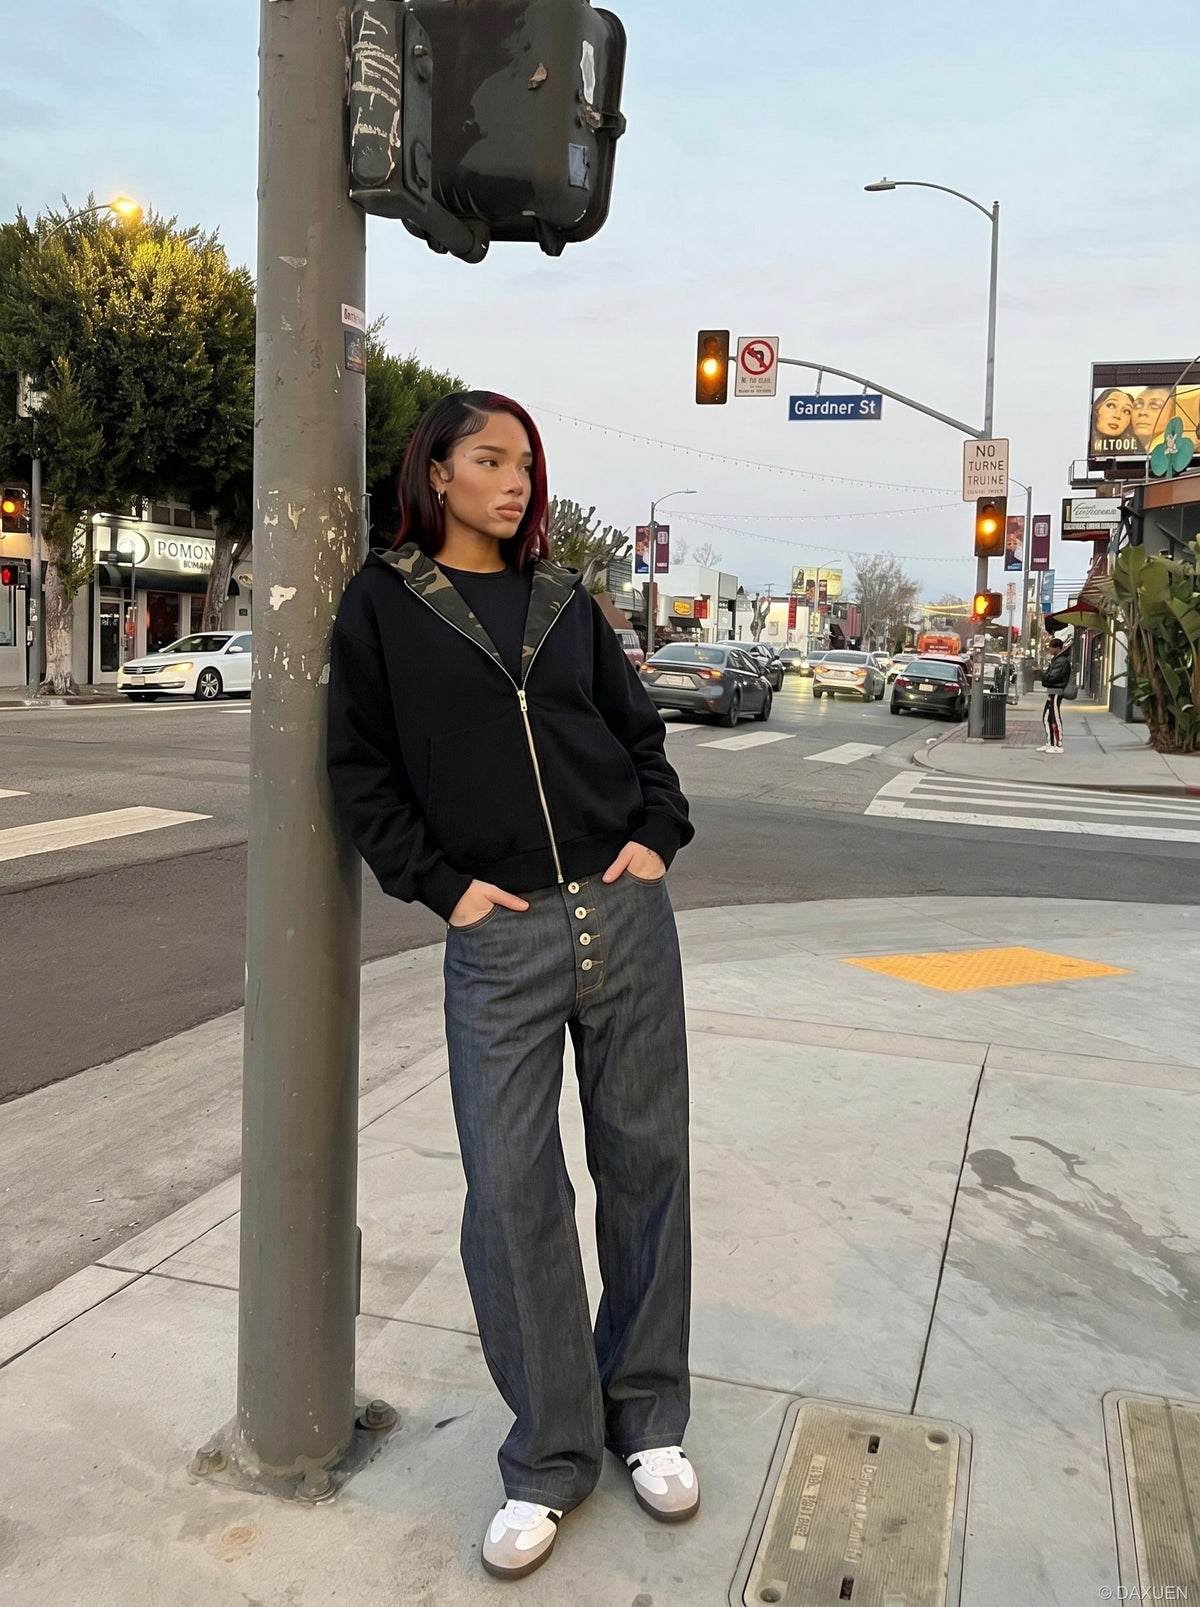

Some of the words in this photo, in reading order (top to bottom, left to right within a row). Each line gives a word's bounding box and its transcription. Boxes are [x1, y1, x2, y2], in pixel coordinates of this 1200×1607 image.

[794, 400, 854, 415] Gardner
[859, 400, 876, 415] St
[976, 444, 996, 457] NO
